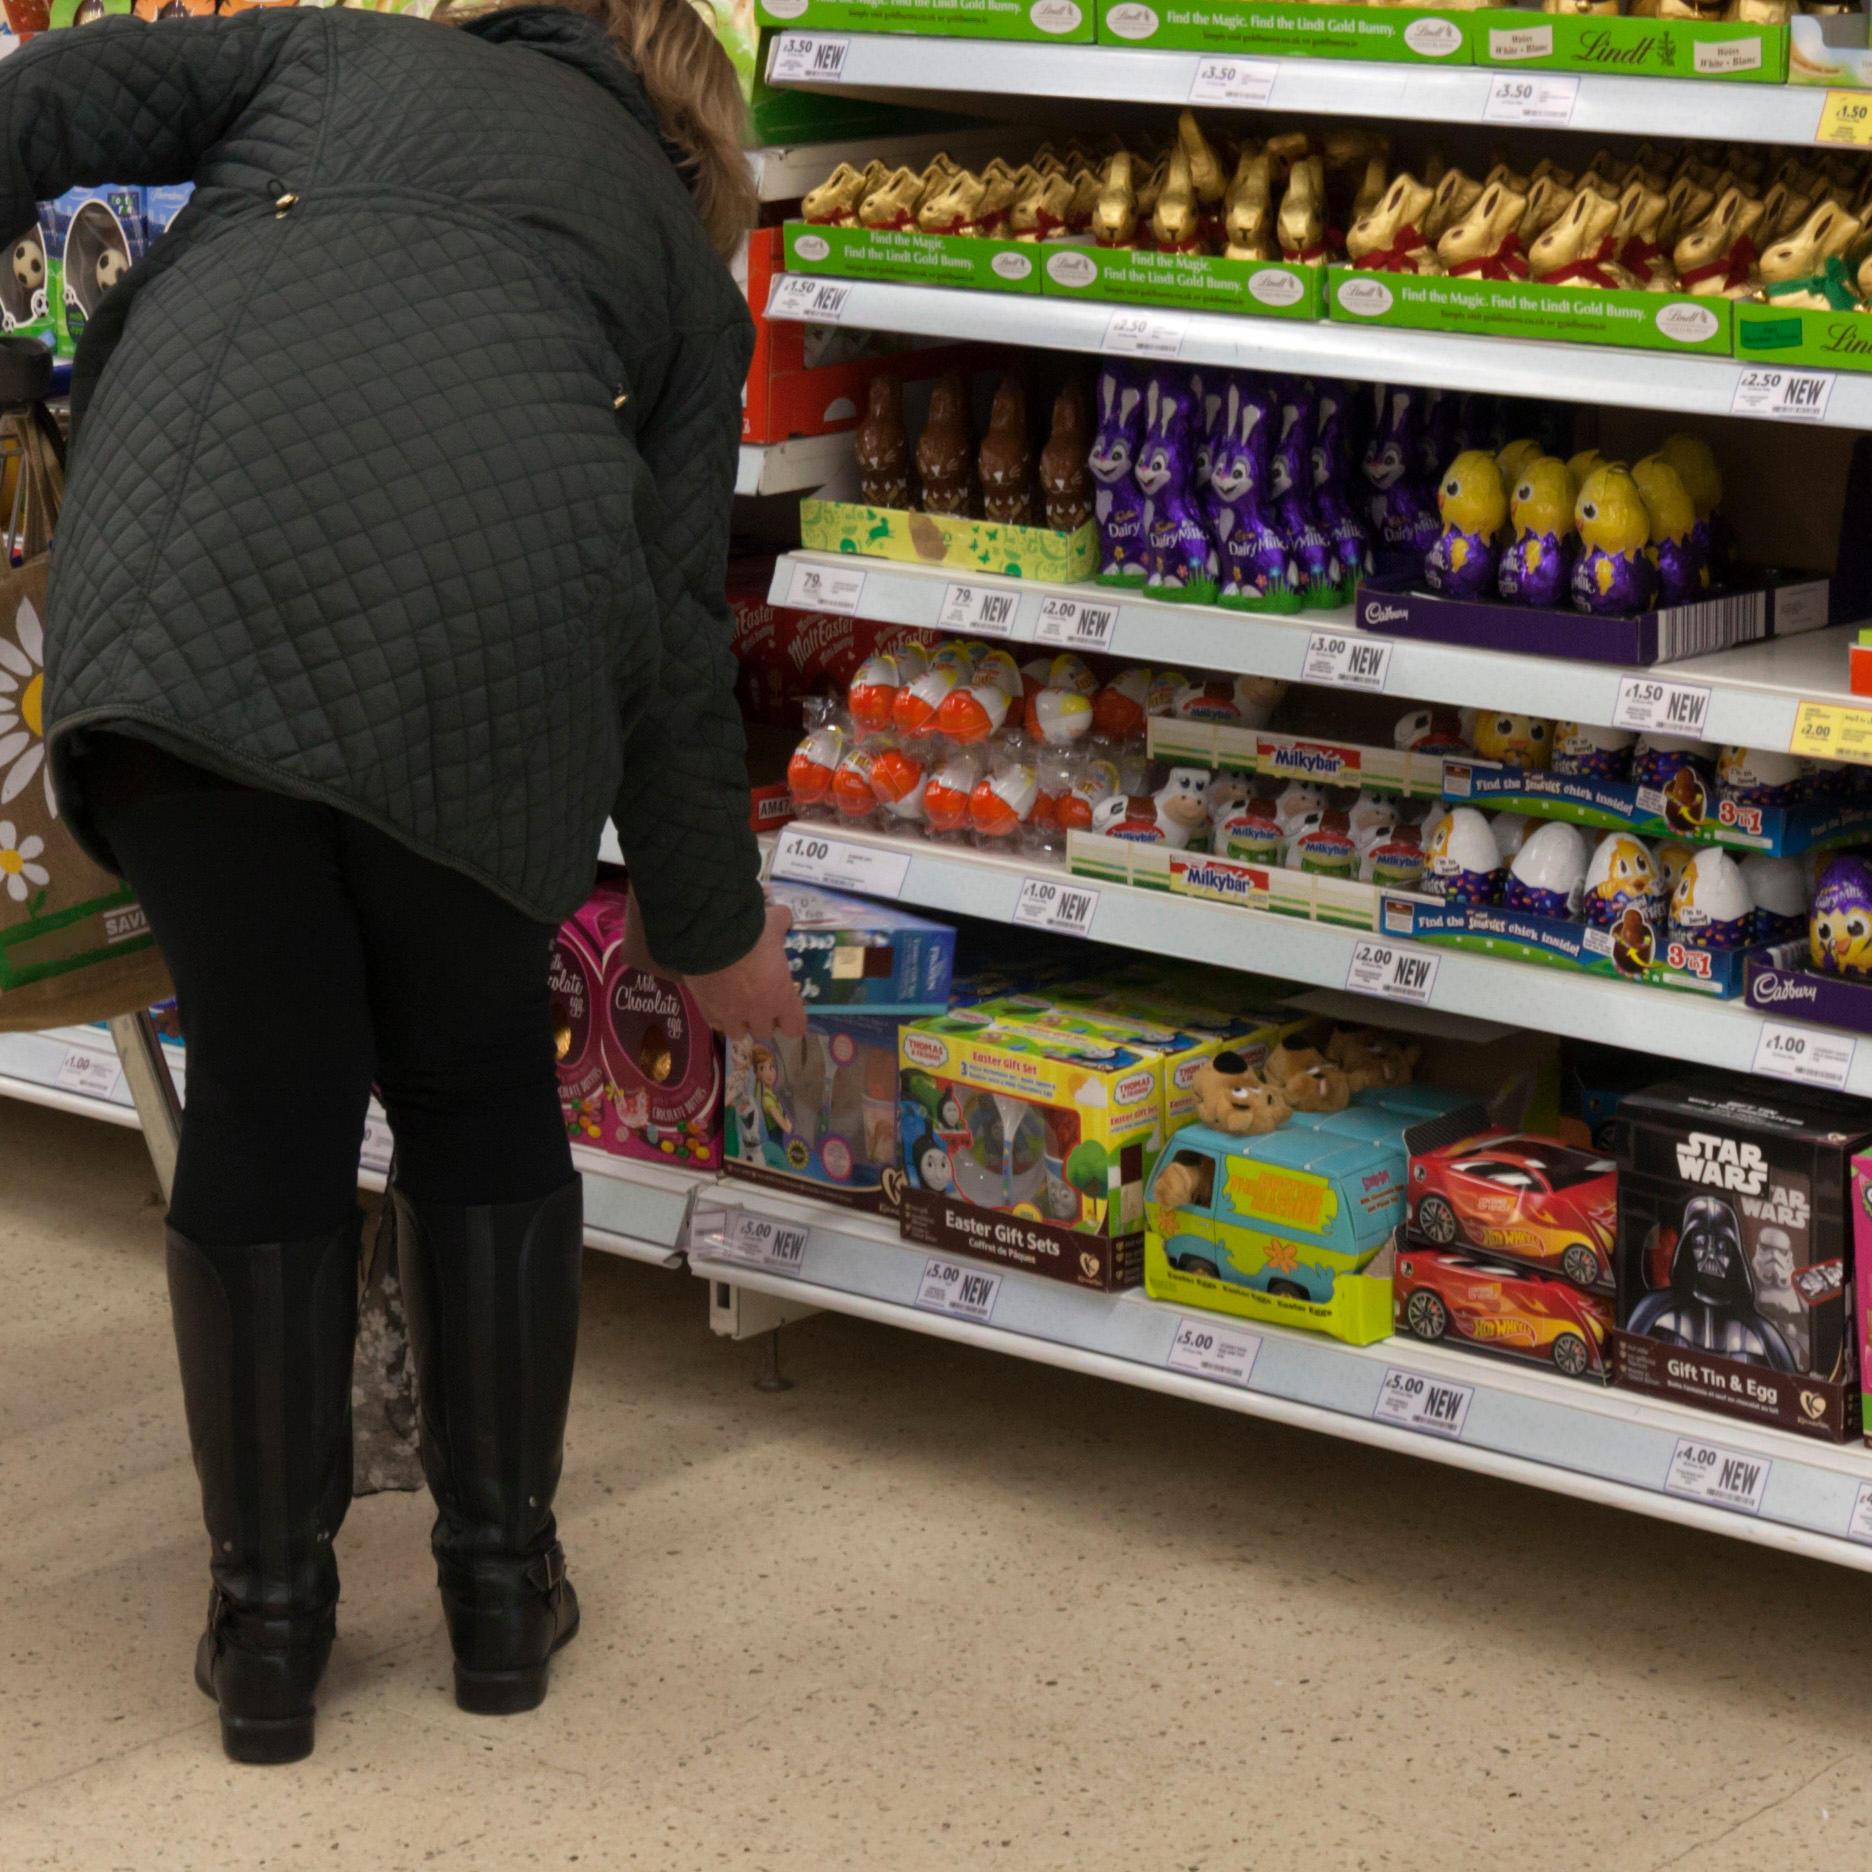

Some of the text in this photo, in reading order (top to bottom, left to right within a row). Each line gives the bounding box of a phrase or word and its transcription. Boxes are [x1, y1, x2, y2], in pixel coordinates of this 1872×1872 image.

[1572, 31, 1656, 67] Lindt
[1402, 289, 1427, 304] Find
[1429, 291, 1447, 306] the
[1450, 292, 1488, 310] Magic.
[1491, 294, 1517, 309] Find
[1520, 296, 1538, 312] the
[1540, 297, 1571, 315] Lindt
[1573, 300, 1604, 317] Gold
[1605, 302, 1646, 323] Bunny.
[1185, 866, 1250, 895] Milkybar
[1676, 1132, 1768, 1168] STAR
[1679, 1157, 1768, 1194] WARS
[944, 1208, 1061, 1259] Easter Gift Sets
[1667, 1358, 1702, 1383] Gift
[1704, 1367, 1729, 1388] Tin
[1730, 1372, 1739, 1392] &
[1740, 1378, 1779, 1406] Egg
[1676, 1446, 1760, 1493] £4.00 NEW
